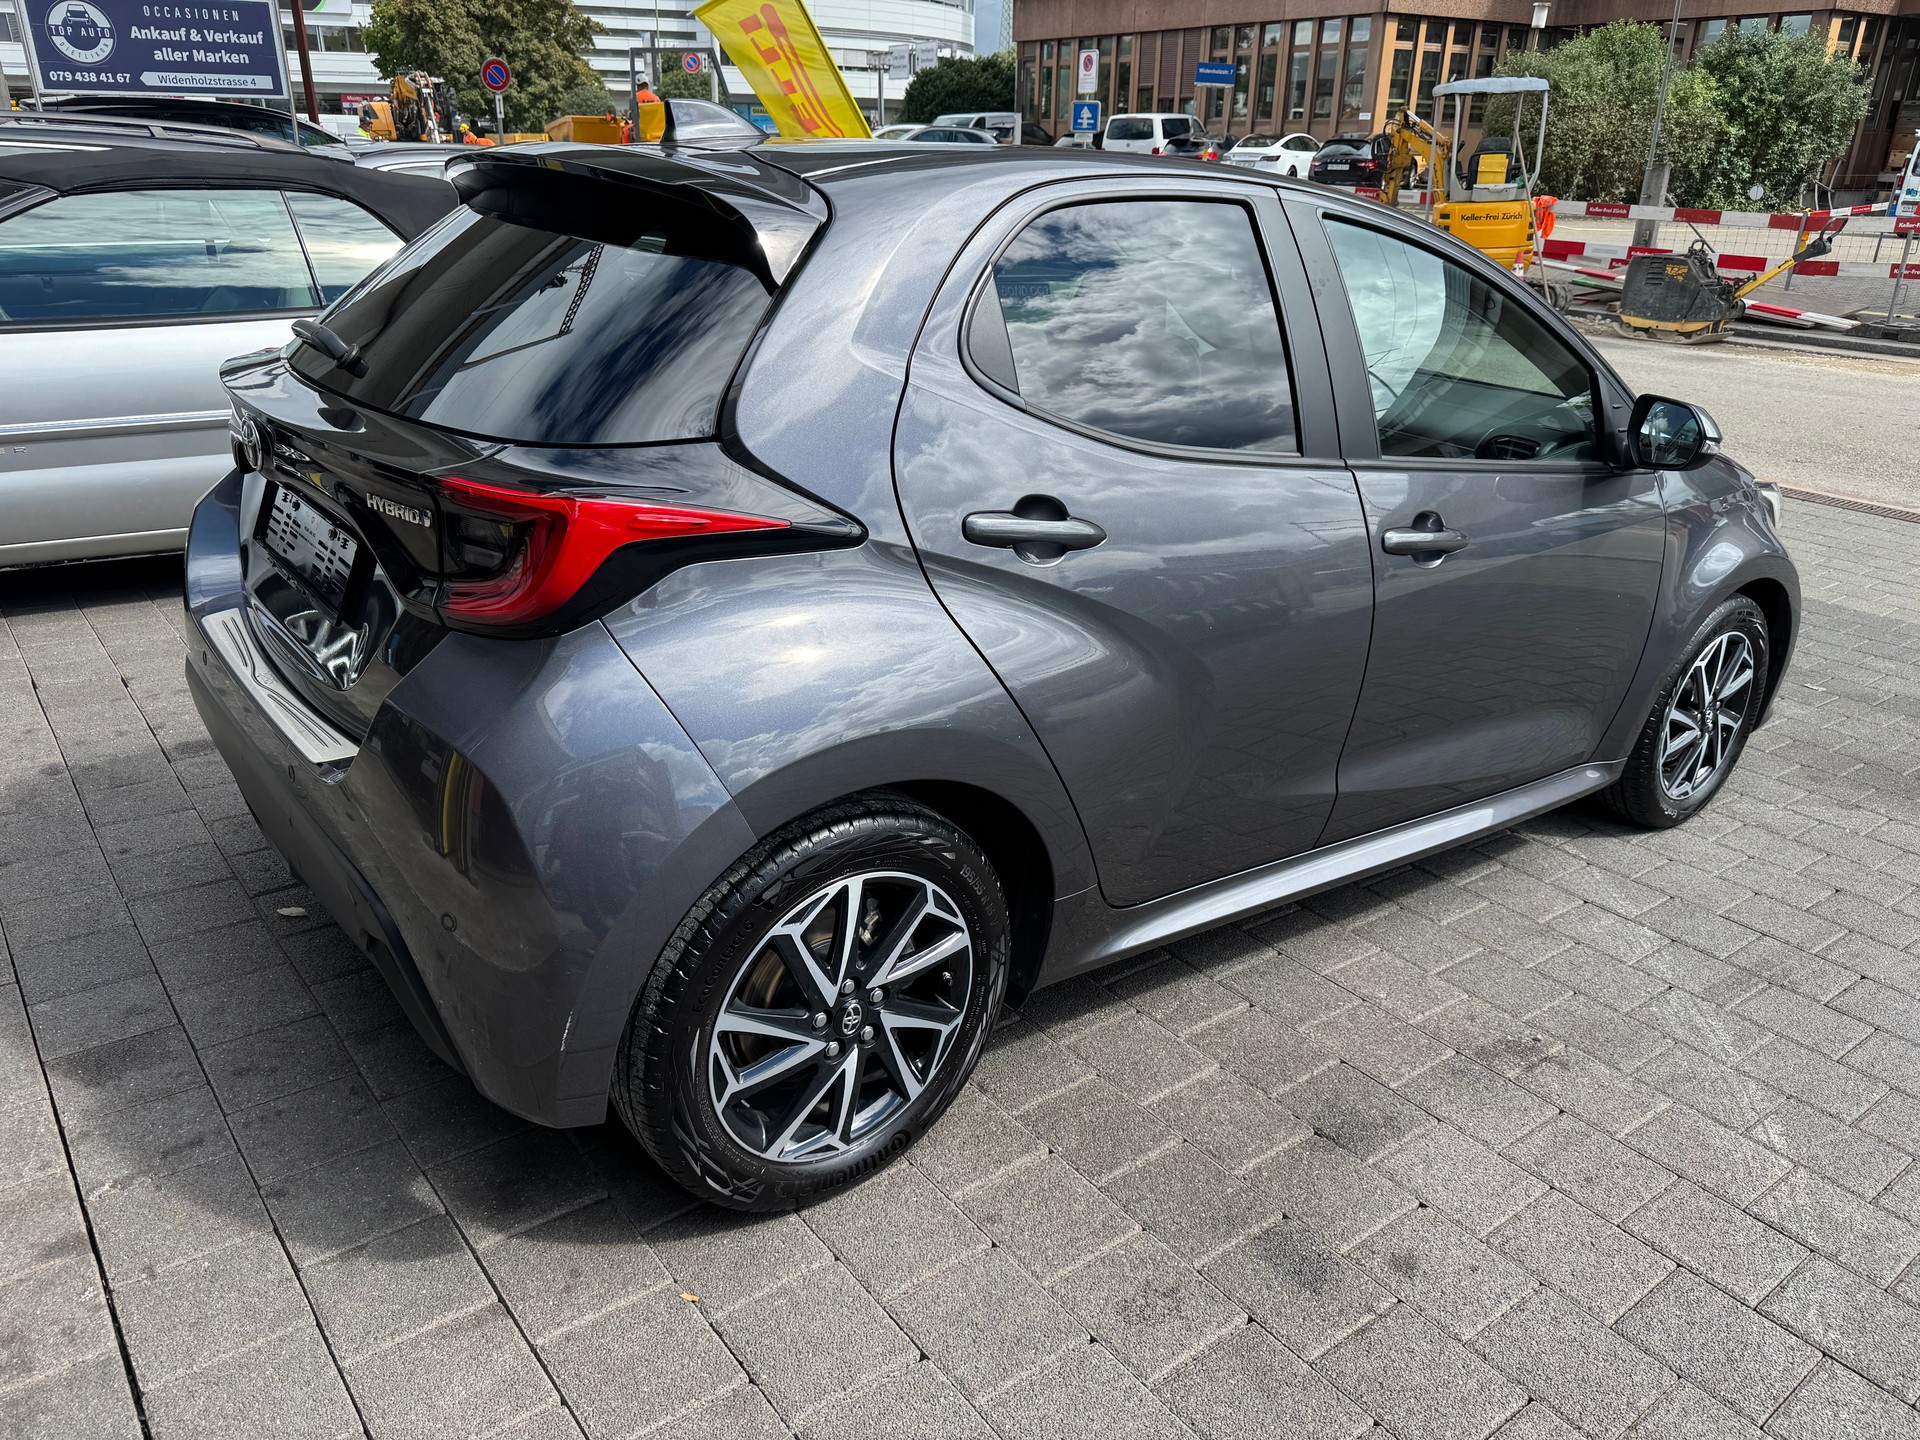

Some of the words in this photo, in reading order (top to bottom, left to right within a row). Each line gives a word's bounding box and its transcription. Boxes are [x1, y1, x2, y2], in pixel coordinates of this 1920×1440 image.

[143, 5, 239, 21] OCCASIONEN
[50, 25, 73, 36] TOP
[81, 27, 110, 38] AUTO
[130, 26, 186, 41] Ankauf
[189, 29, 202, 42] &
[203, 29, 263, 44] Verkauf
[59, 41, 110, 60] DIETLIKON
[153, 47, 190, 62] aller
[192, 49, 250, 64] Marken
[49, 70, 72, 82] 079
[74, 71, 98, 82] 438
[99, 72, 115, 82] 41
[116, 73, 131, 83] 67
[157, 75, 249, 87] Widenholzstrasse
[250, 78, 257, 87] 4
[1501, 211, 1523, 220] Zürich
[366, 492, 420, 525] HYBRID
[693, 931, 745, 1014] EcoContact
[743, 919, 754, 932] 6
